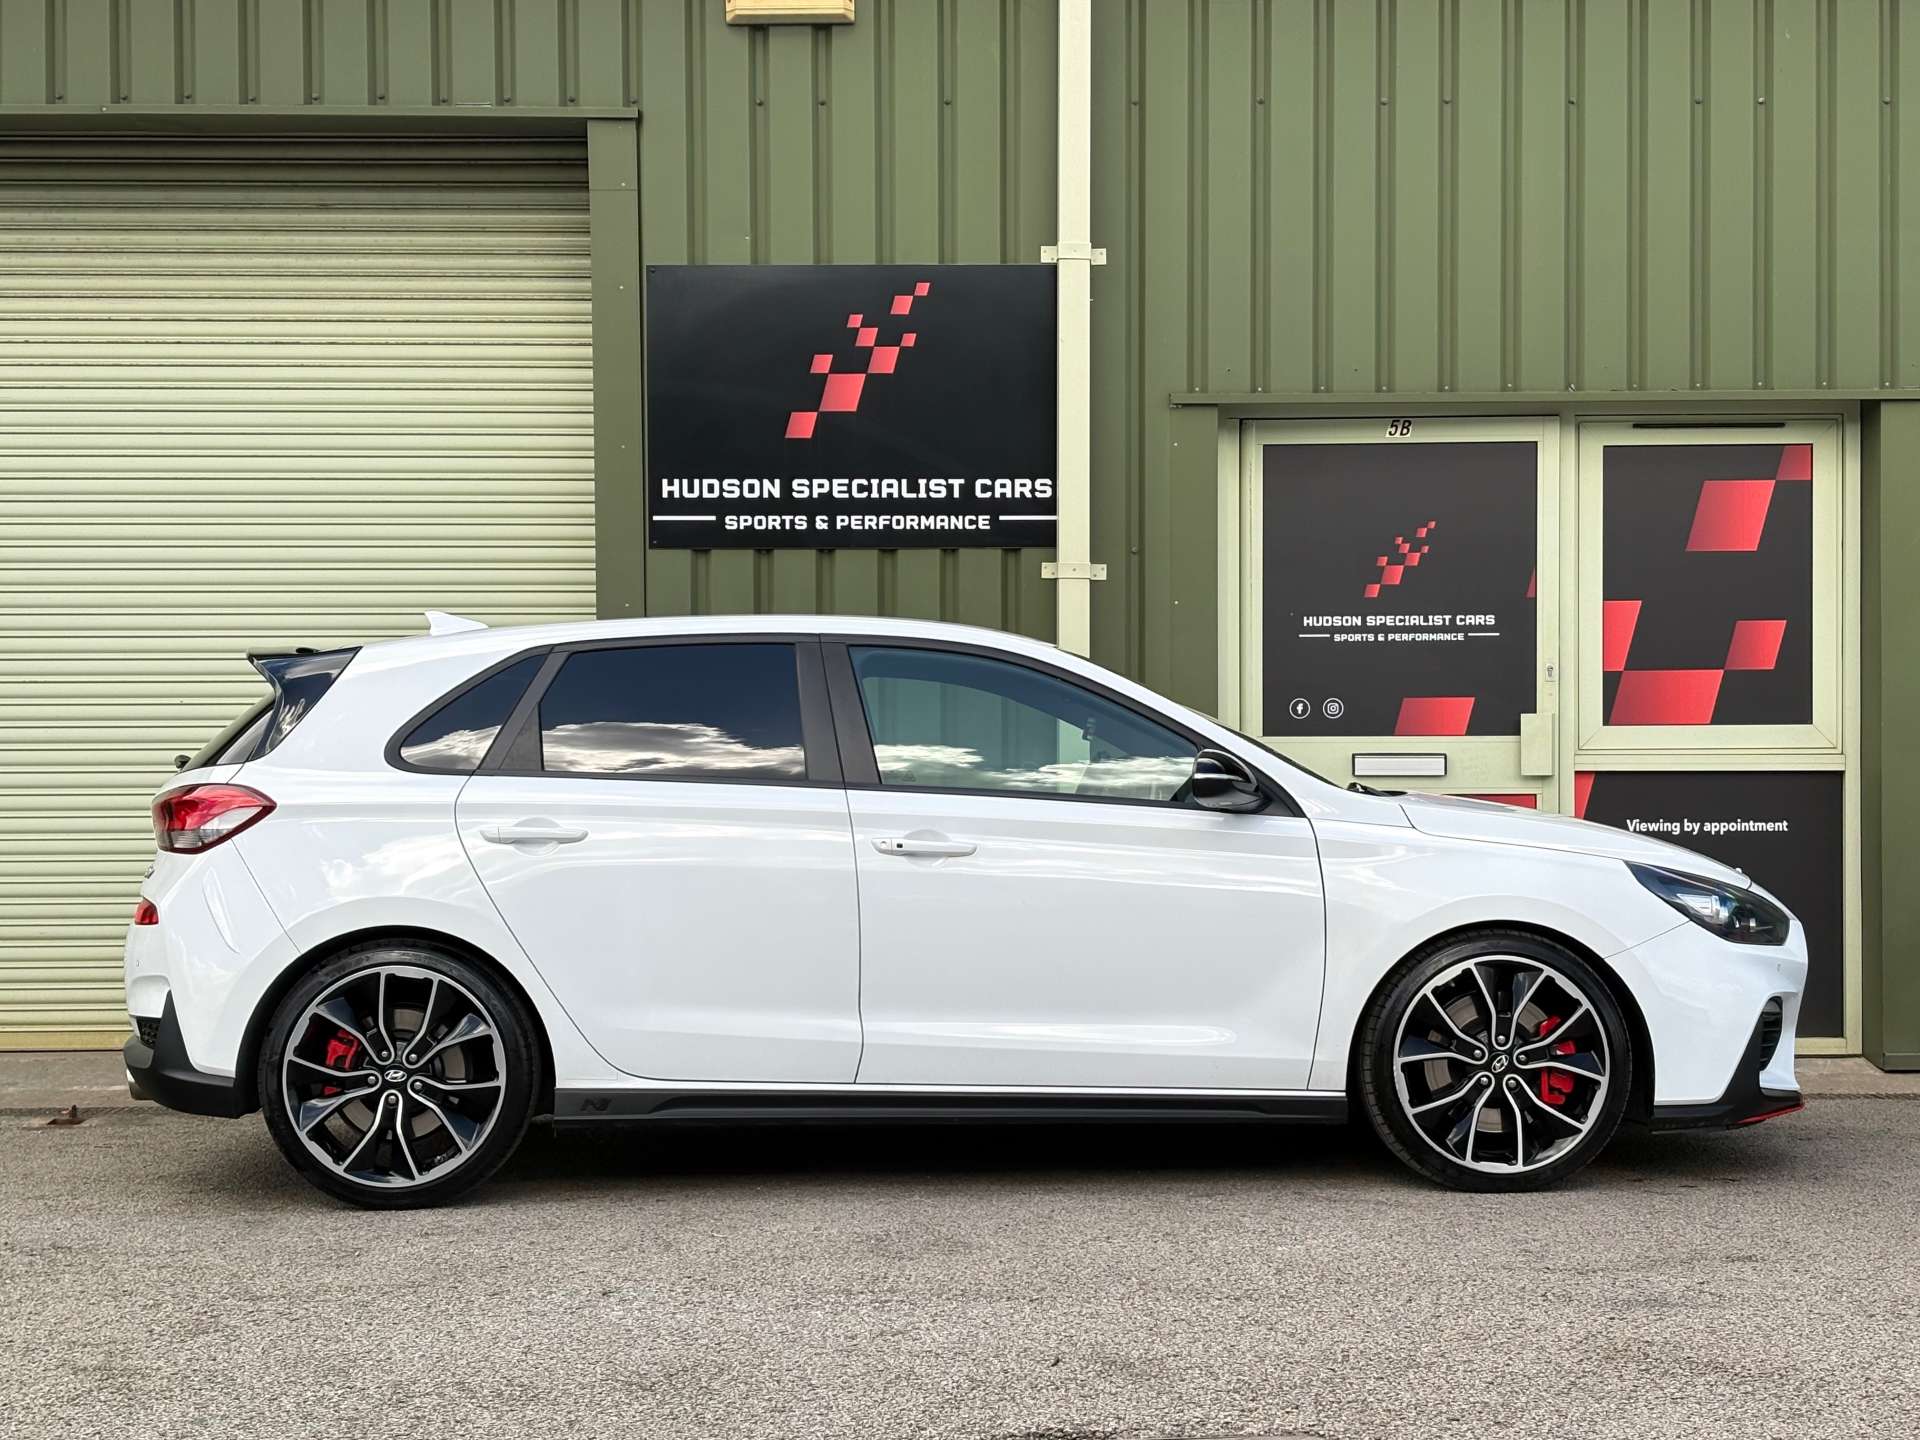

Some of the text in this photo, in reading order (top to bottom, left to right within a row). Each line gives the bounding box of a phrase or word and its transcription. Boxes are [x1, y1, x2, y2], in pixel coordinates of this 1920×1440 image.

[1387, 419, 1413, 437] 5B
[660, 478, 1053, 499] HUDSON SPECIALIST CARS
[724, 514, 991, 531] SPORTS & PERFORMANCE
[1303, 614, 1496, 627] HUDSON SPECIALIST CARS
[1333, 633, 1375, 642] SPORTS
[1387, 632, 1465, 642] PERFORMANCE
[1626, 818, 1789, 835] Viewing by appointment
